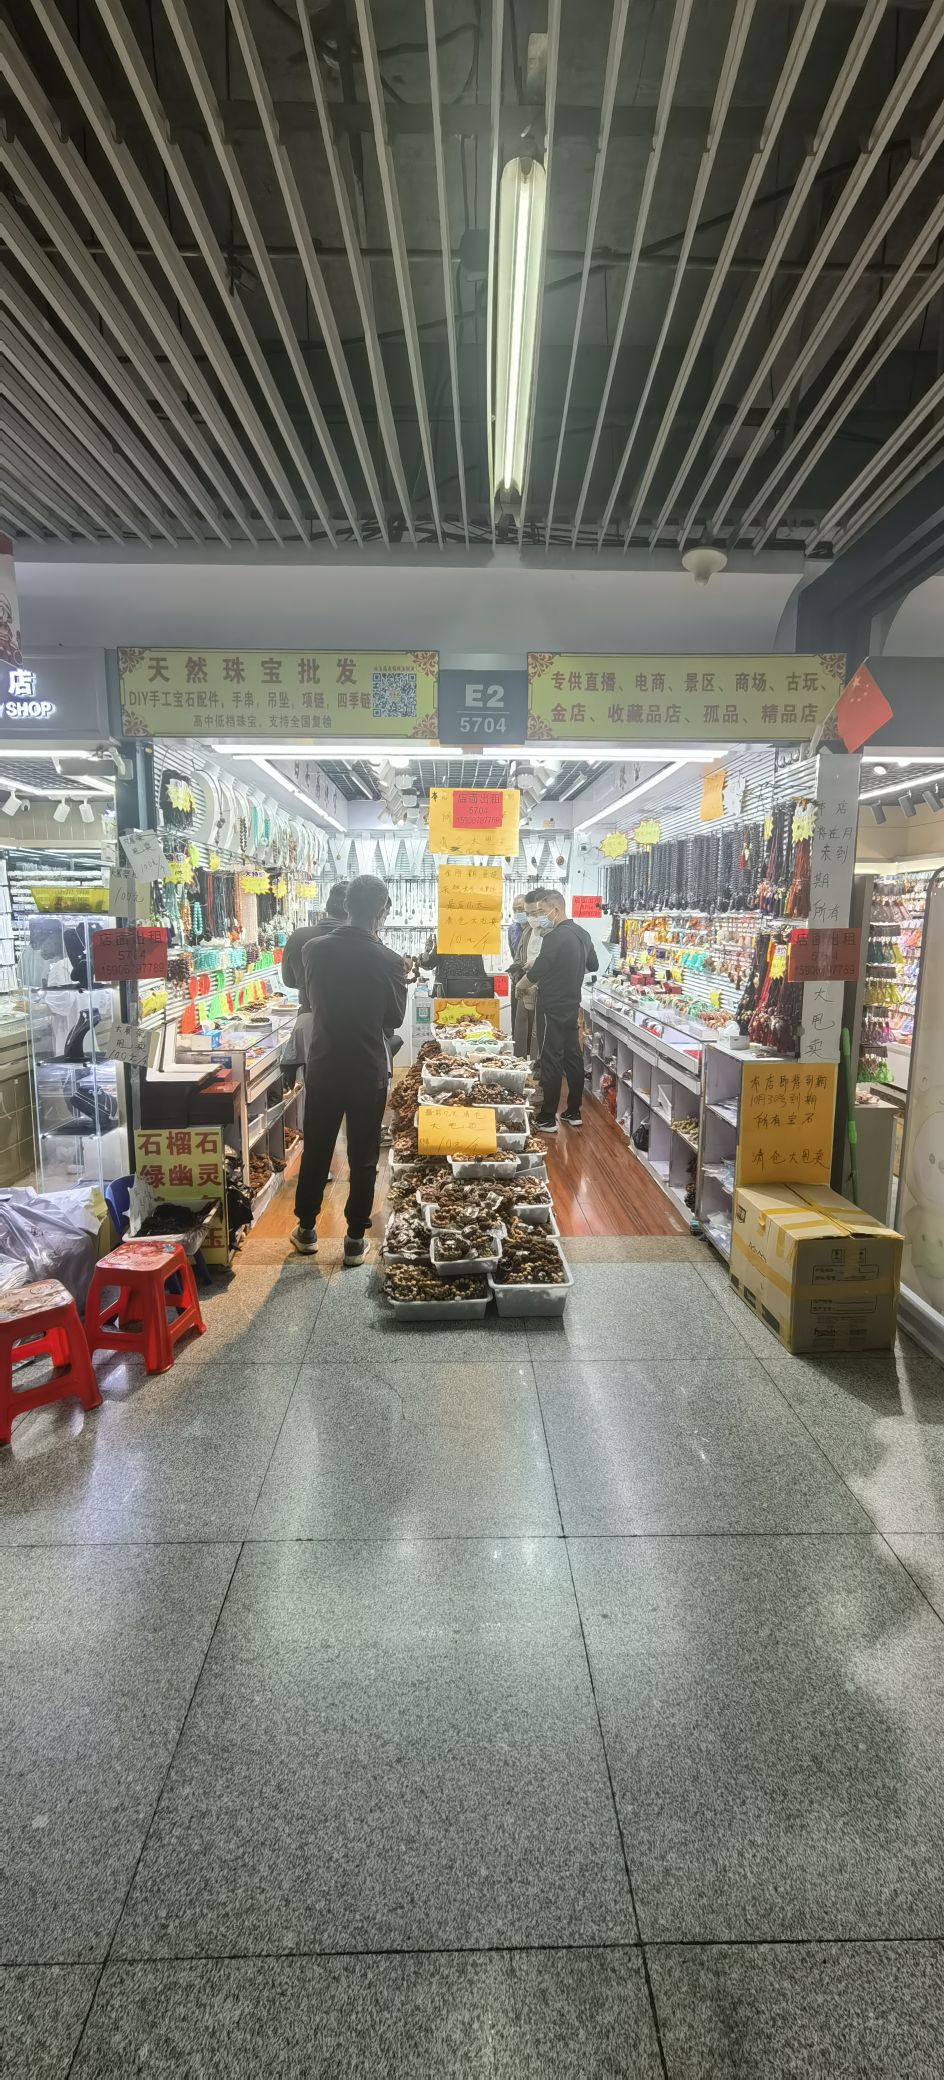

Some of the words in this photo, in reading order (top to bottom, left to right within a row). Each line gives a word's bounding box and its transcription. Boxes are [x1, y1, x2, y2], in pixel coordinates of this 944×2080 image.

[8, 668, 36, 697] 店
[148, 657, 357, 685] 天然珠宝批发
[465, 684, 505, 708] E2
[5, 701, 56, 719] SHOP
[460, 717, 506, 733] 5704
[137, 1131, 219, 1156] 石榴石
[140, 1163, 222, 1188] 绿幽灵
